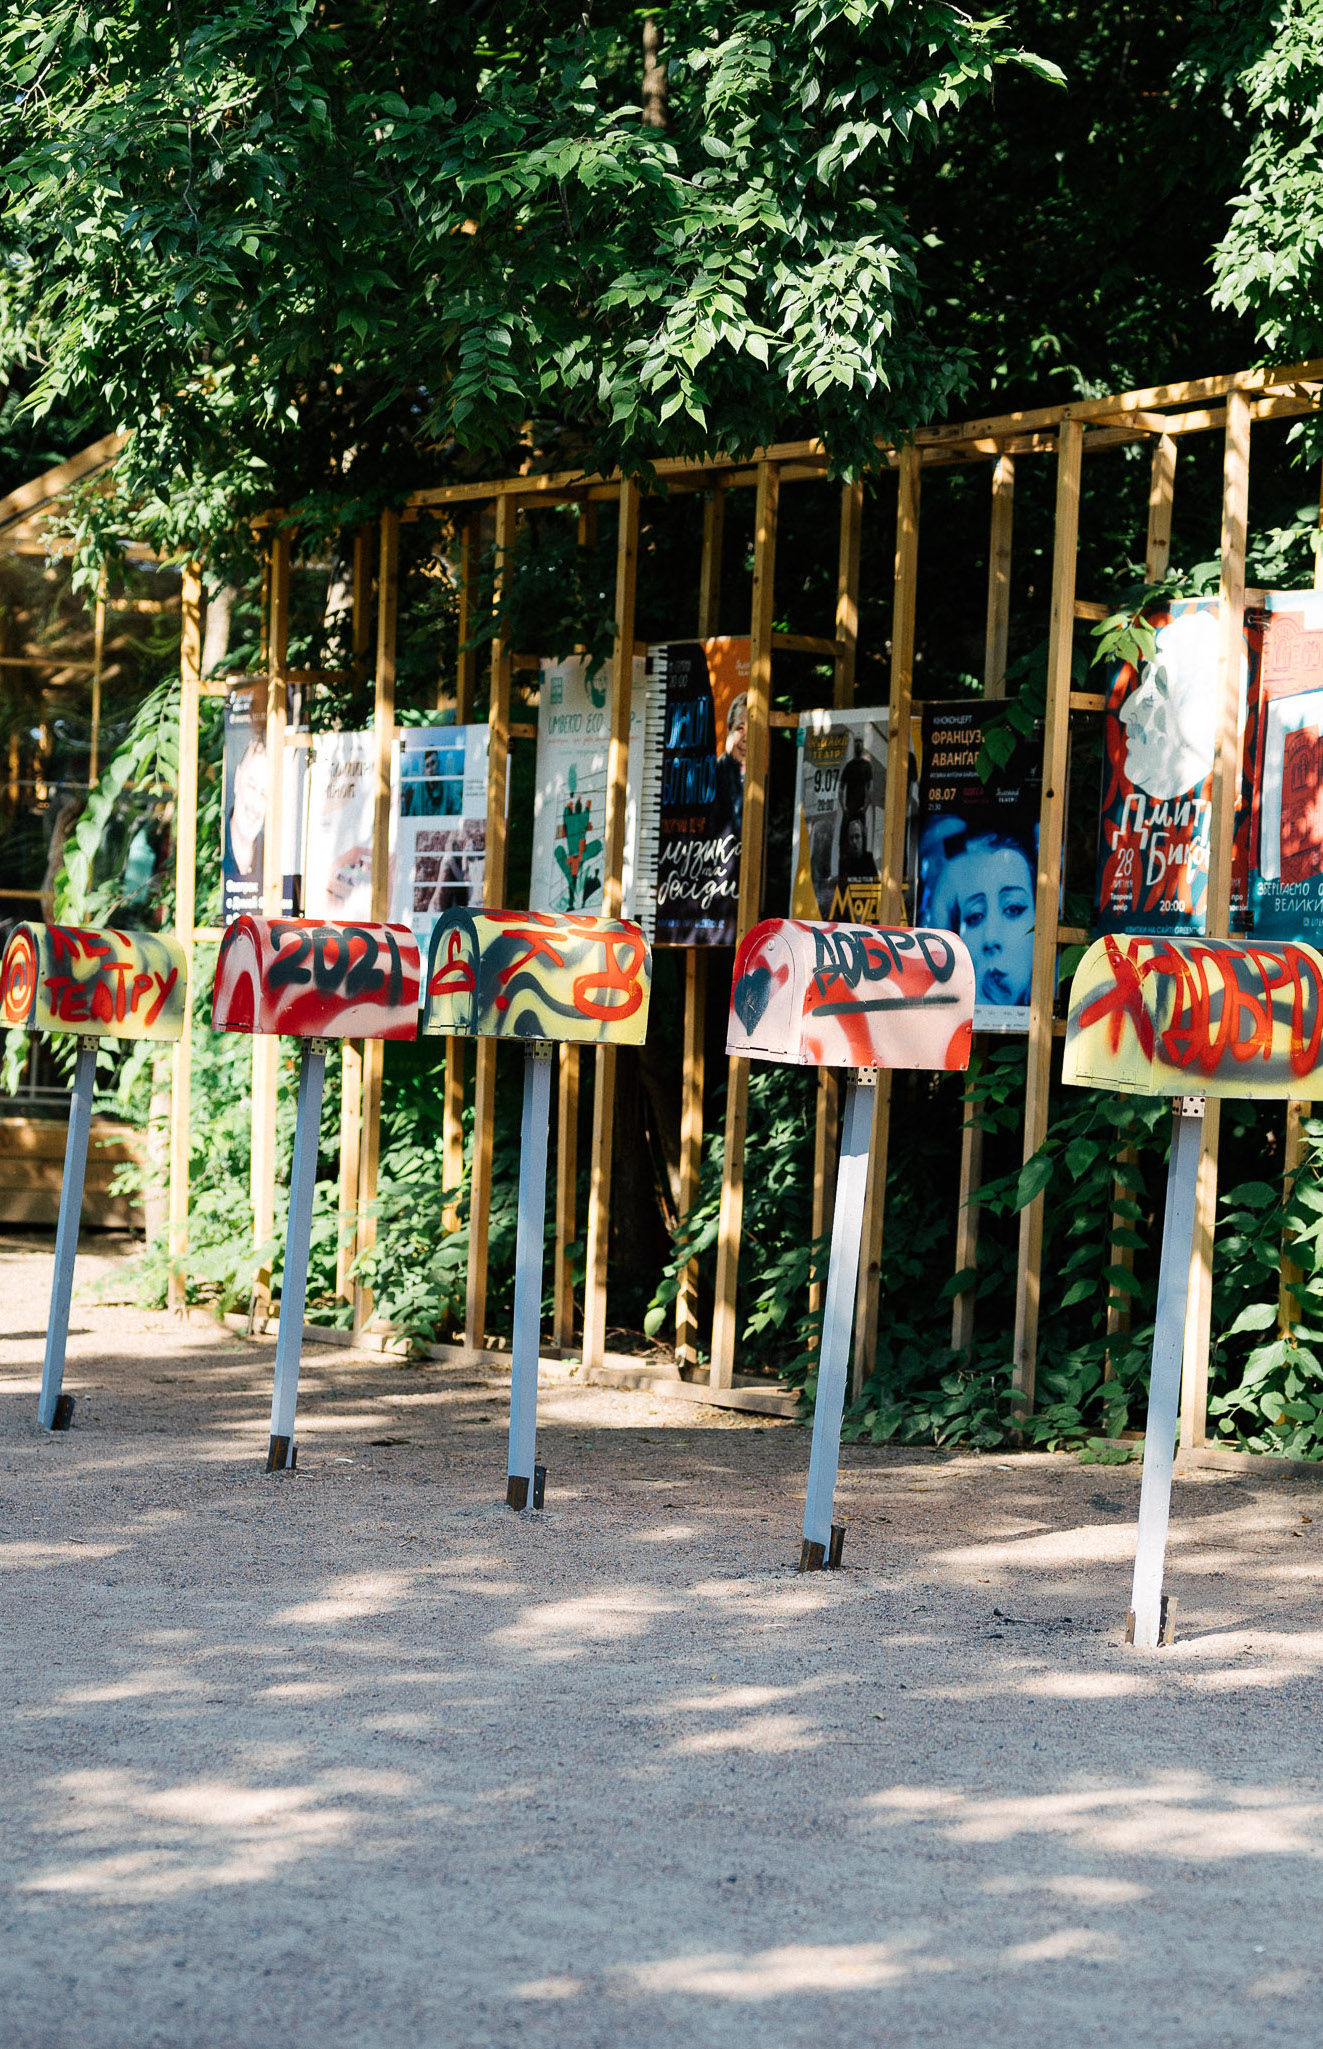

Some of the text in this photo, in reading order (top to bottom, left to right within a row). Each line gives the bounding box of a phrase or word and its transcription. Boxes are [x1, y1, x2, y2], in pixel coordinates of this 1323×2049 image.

[931, 729, 985, 745] ФРАНЦУЗ
[814, 768, 840, 793] 9.07
[928, 788, 957, 801] 08.07
[1114, 848, 1134, 877] 28
[657, 870, 740, 910] бесіди
[1231, 894, 1244, 902] про
[1257, 880, 1310, 897] ЗБЕРІГАЄМО
[1159, 900, 1186, 912] 20:00
[1274, 898, 1323, 912] ВЕЛИКИ
[267, 923, 405, 1007] 2021
[813, 926, 955, 998] ДОБРО
[43, 962, 178, 1027] ТЕАТРУ
